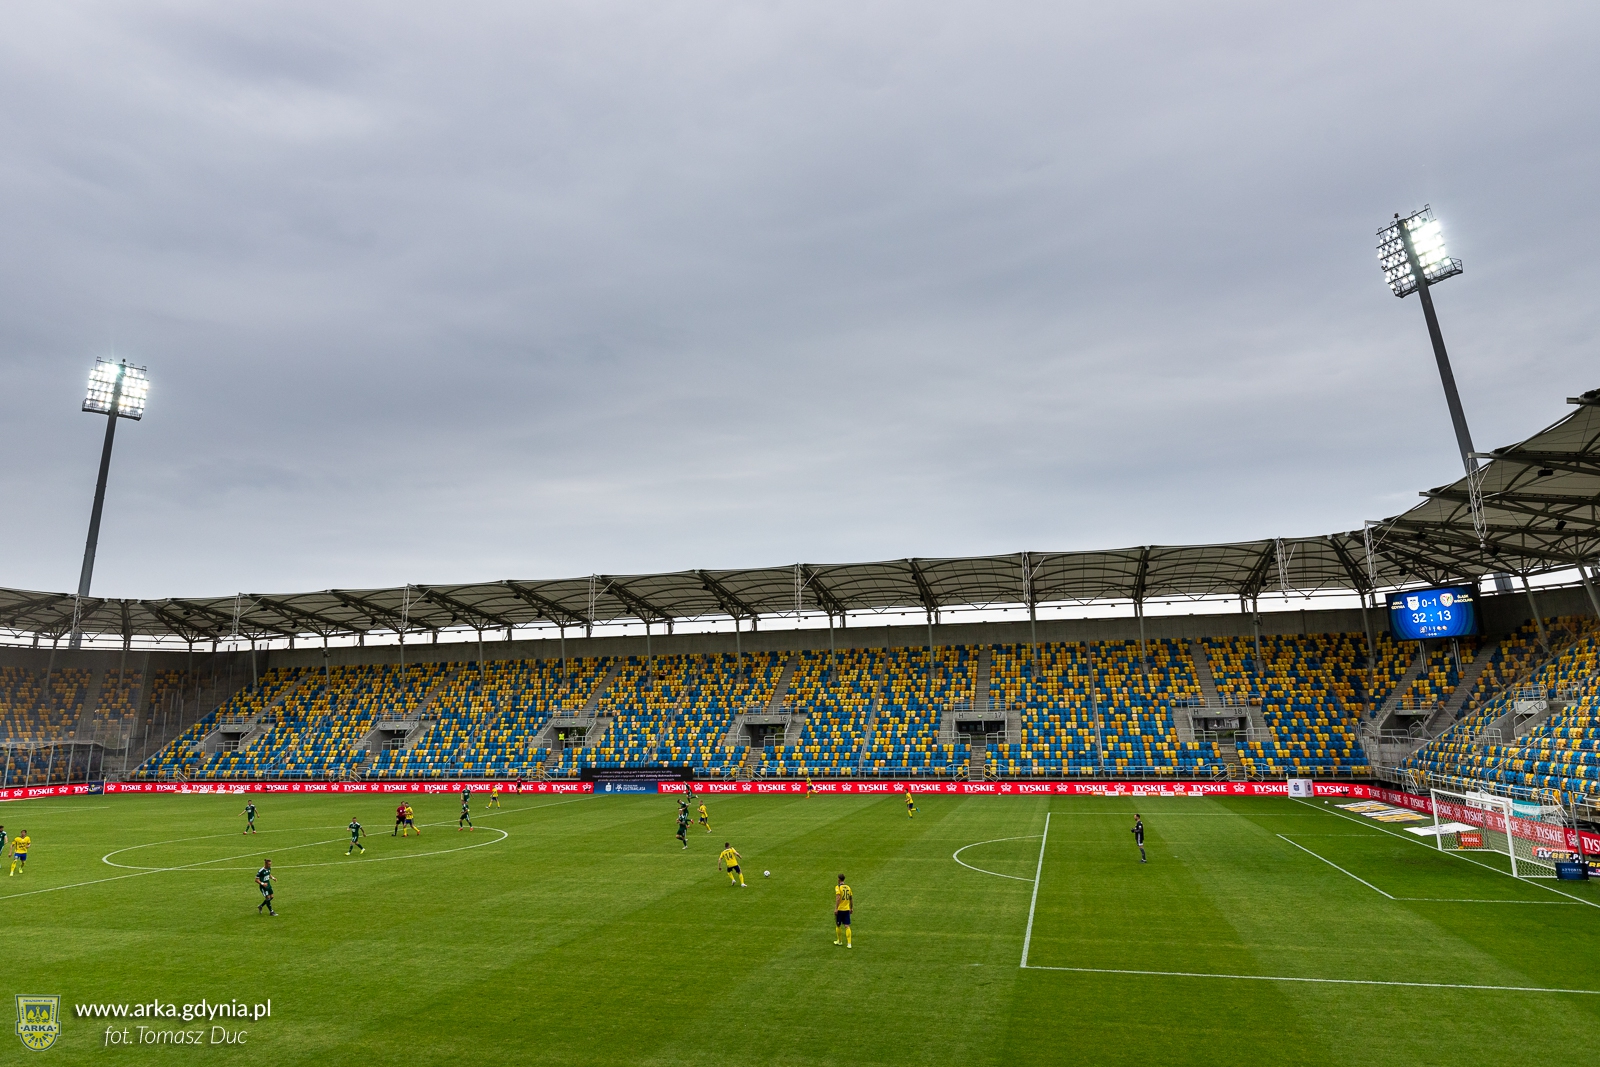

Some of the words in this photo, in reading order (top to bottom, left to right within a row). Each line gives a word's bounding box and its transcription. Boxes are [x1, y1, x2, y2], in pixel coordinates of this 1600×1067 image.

[1421, 598, 1437, 607] 0-1
[1412, 613, 1427, 624] 32
[1437, 610, 1452, 621] 13
[28, 787, 54, 796] TYSKIE
[962, 784, 995, 792] TYSKIE
[1017, 784, 1051, 792] TYSKIE
[1073, 784, 1108, 792] TYSKIE
[1131, 784, 1167, 792] TYSKIE
[1191, 784, 1227, 792] TYSKIE
[1409, 797, 1425, 809] TYSKIE
[1535, 825, 1563, 843] TYSKIE
[1582, 836, 1600, 852] TYS
[842, 889, 849, 900] 26
